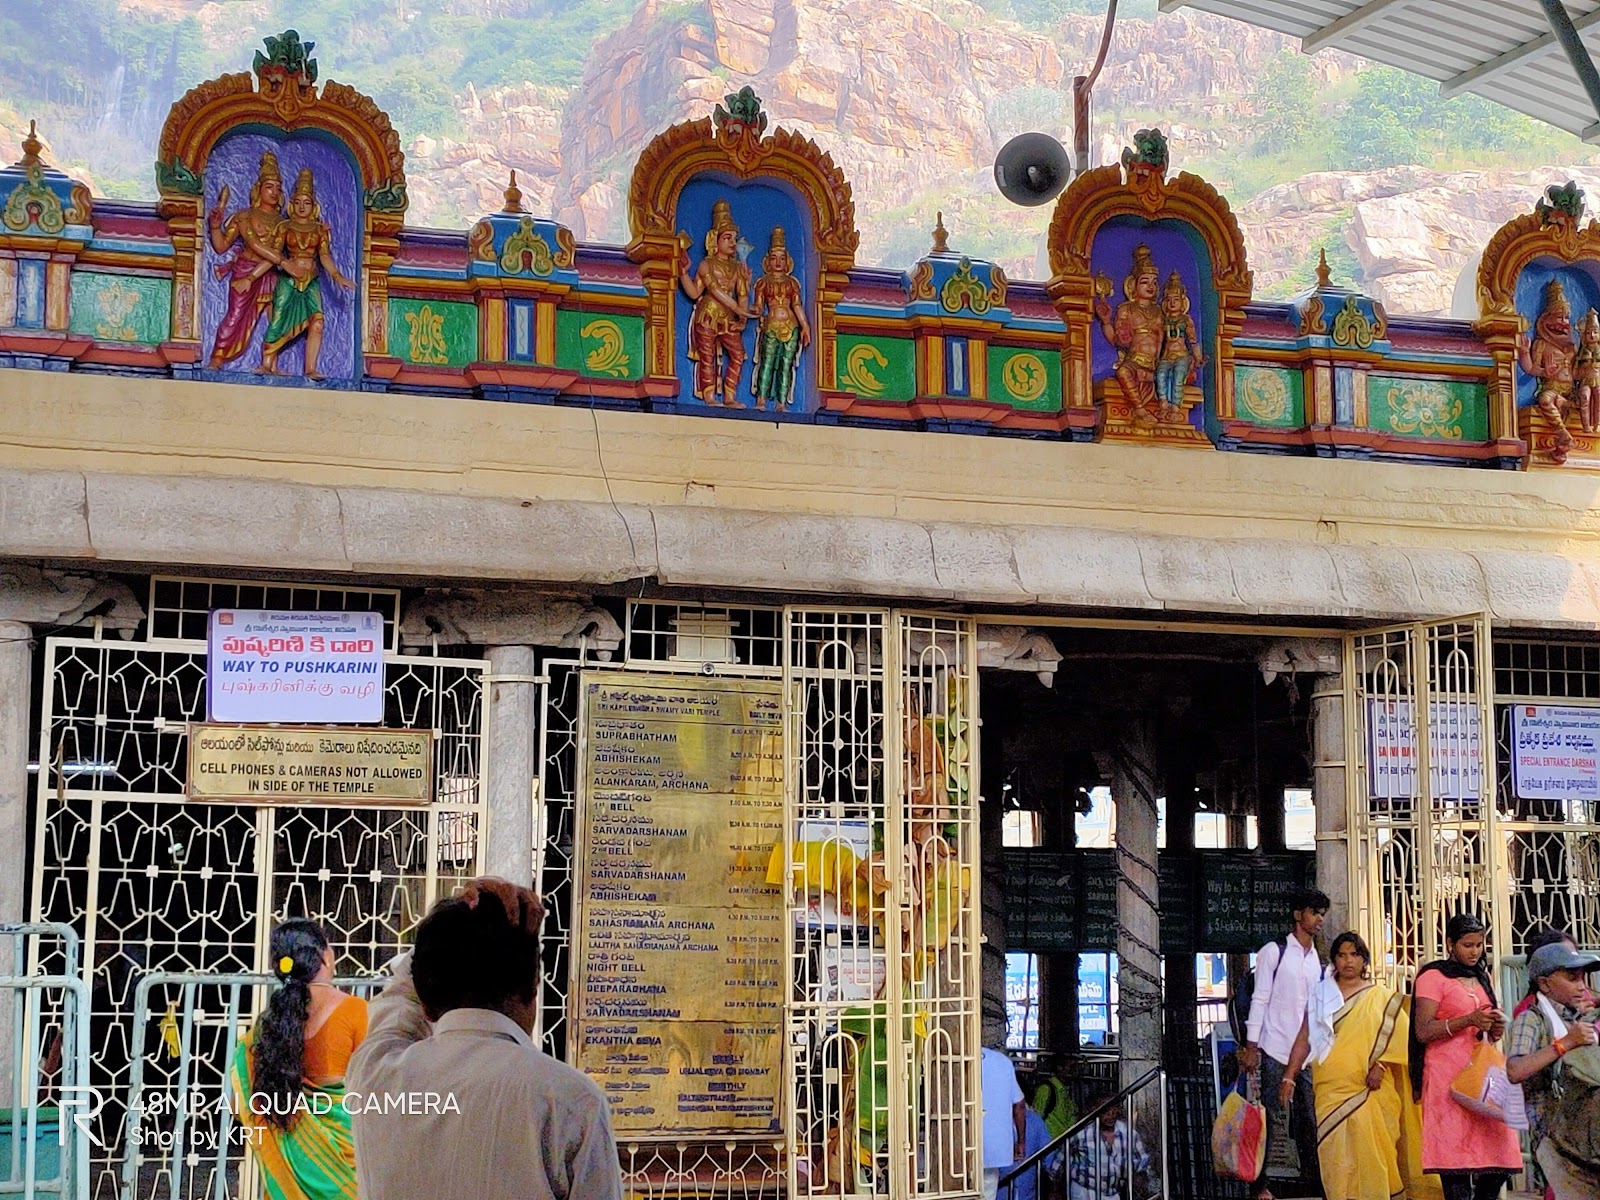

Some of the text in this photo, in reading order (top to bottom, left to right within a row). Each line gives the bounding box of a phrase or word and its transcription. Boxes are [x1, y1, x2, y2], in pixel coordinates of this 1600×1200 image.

[222, 635, 373, 657] పుష్కరిణి కి దారి
[223, 660, 377, 674] WAY TO PUSHKARINI
[340, 681, 376, 699] வழி
[201, 733, 246, 751] ఆలయంలో
[595, 731, 677, 742] SUPRABHATHAM
[594, 754, 661, 765] ABHISHEKAM
[1520, 756, 1597, 768] SPECIAL ENTRANCE DARSHAN
[200, 763, 422, 779] CELL PHONES & CAMERAS NOT ALLOWED
[248, 780, 374, 793] IN SIDE OF THE TEMPLE
[594, 778, 709, 790] ALANKARAM, ARCHANA
[610, 803, 635, 812] BELL
[592, 826, 688, 837] SARVADARSHANAM
[608, 847, 633, 856] BELL
[591, 870, 686, 881] SARVADARSHANAM
[668, 920, 715, 930] ARCHANA
[589, 941, 621, 949] LALITHA
[586, 963, 646, 972] NIGHT BELL
[586, 984, 667, 994] DEEPARADHANA
[585, 1036, 634, 1045] EKANTHA
